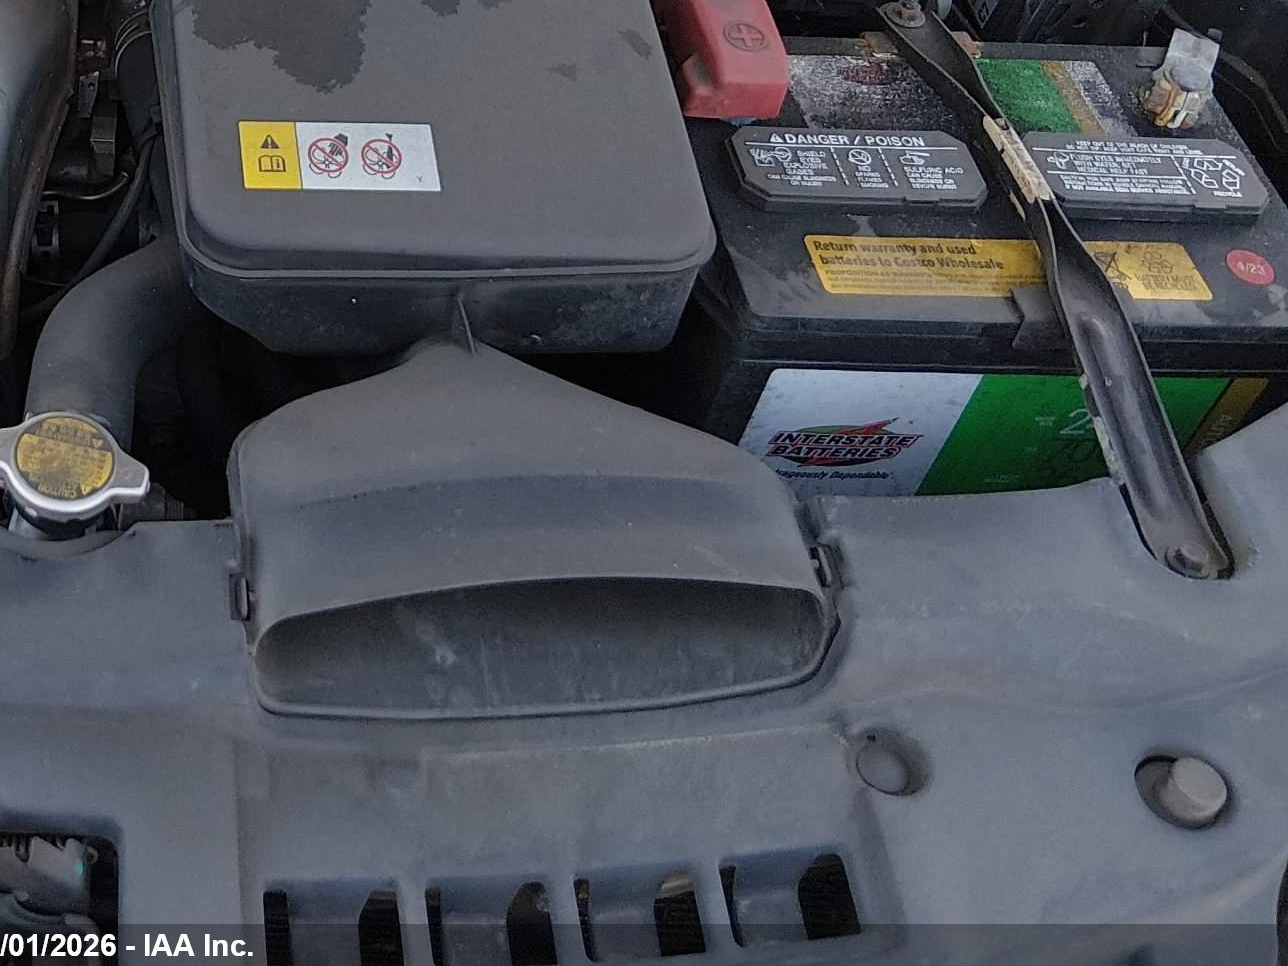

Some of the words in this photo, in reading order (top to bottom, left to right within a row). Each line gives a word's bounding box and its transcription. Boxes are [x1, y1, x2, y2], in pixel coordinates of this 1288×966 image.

[784, 134, 850, 145] DANGER
[866, 136, 925, 147] POISON
[814, 240, 858, 252] Return
[859, 243, 918, 256] warranty
[919, 243, 944, 254] and
[946, 244, 976, 255] used
[820, 255, 878, 266] batteries
[879, 257, 892, 267] to
[894, 256, 936, 268] Costco
[937, 258, 1004, 270] Wholesale
[770, 432, 920, 448] INTERSTATE
[768, 446, 902, 458] BATTERIES
[776, 470, 828, 480] rageously
[829, 471, 889, 480] Dependable
